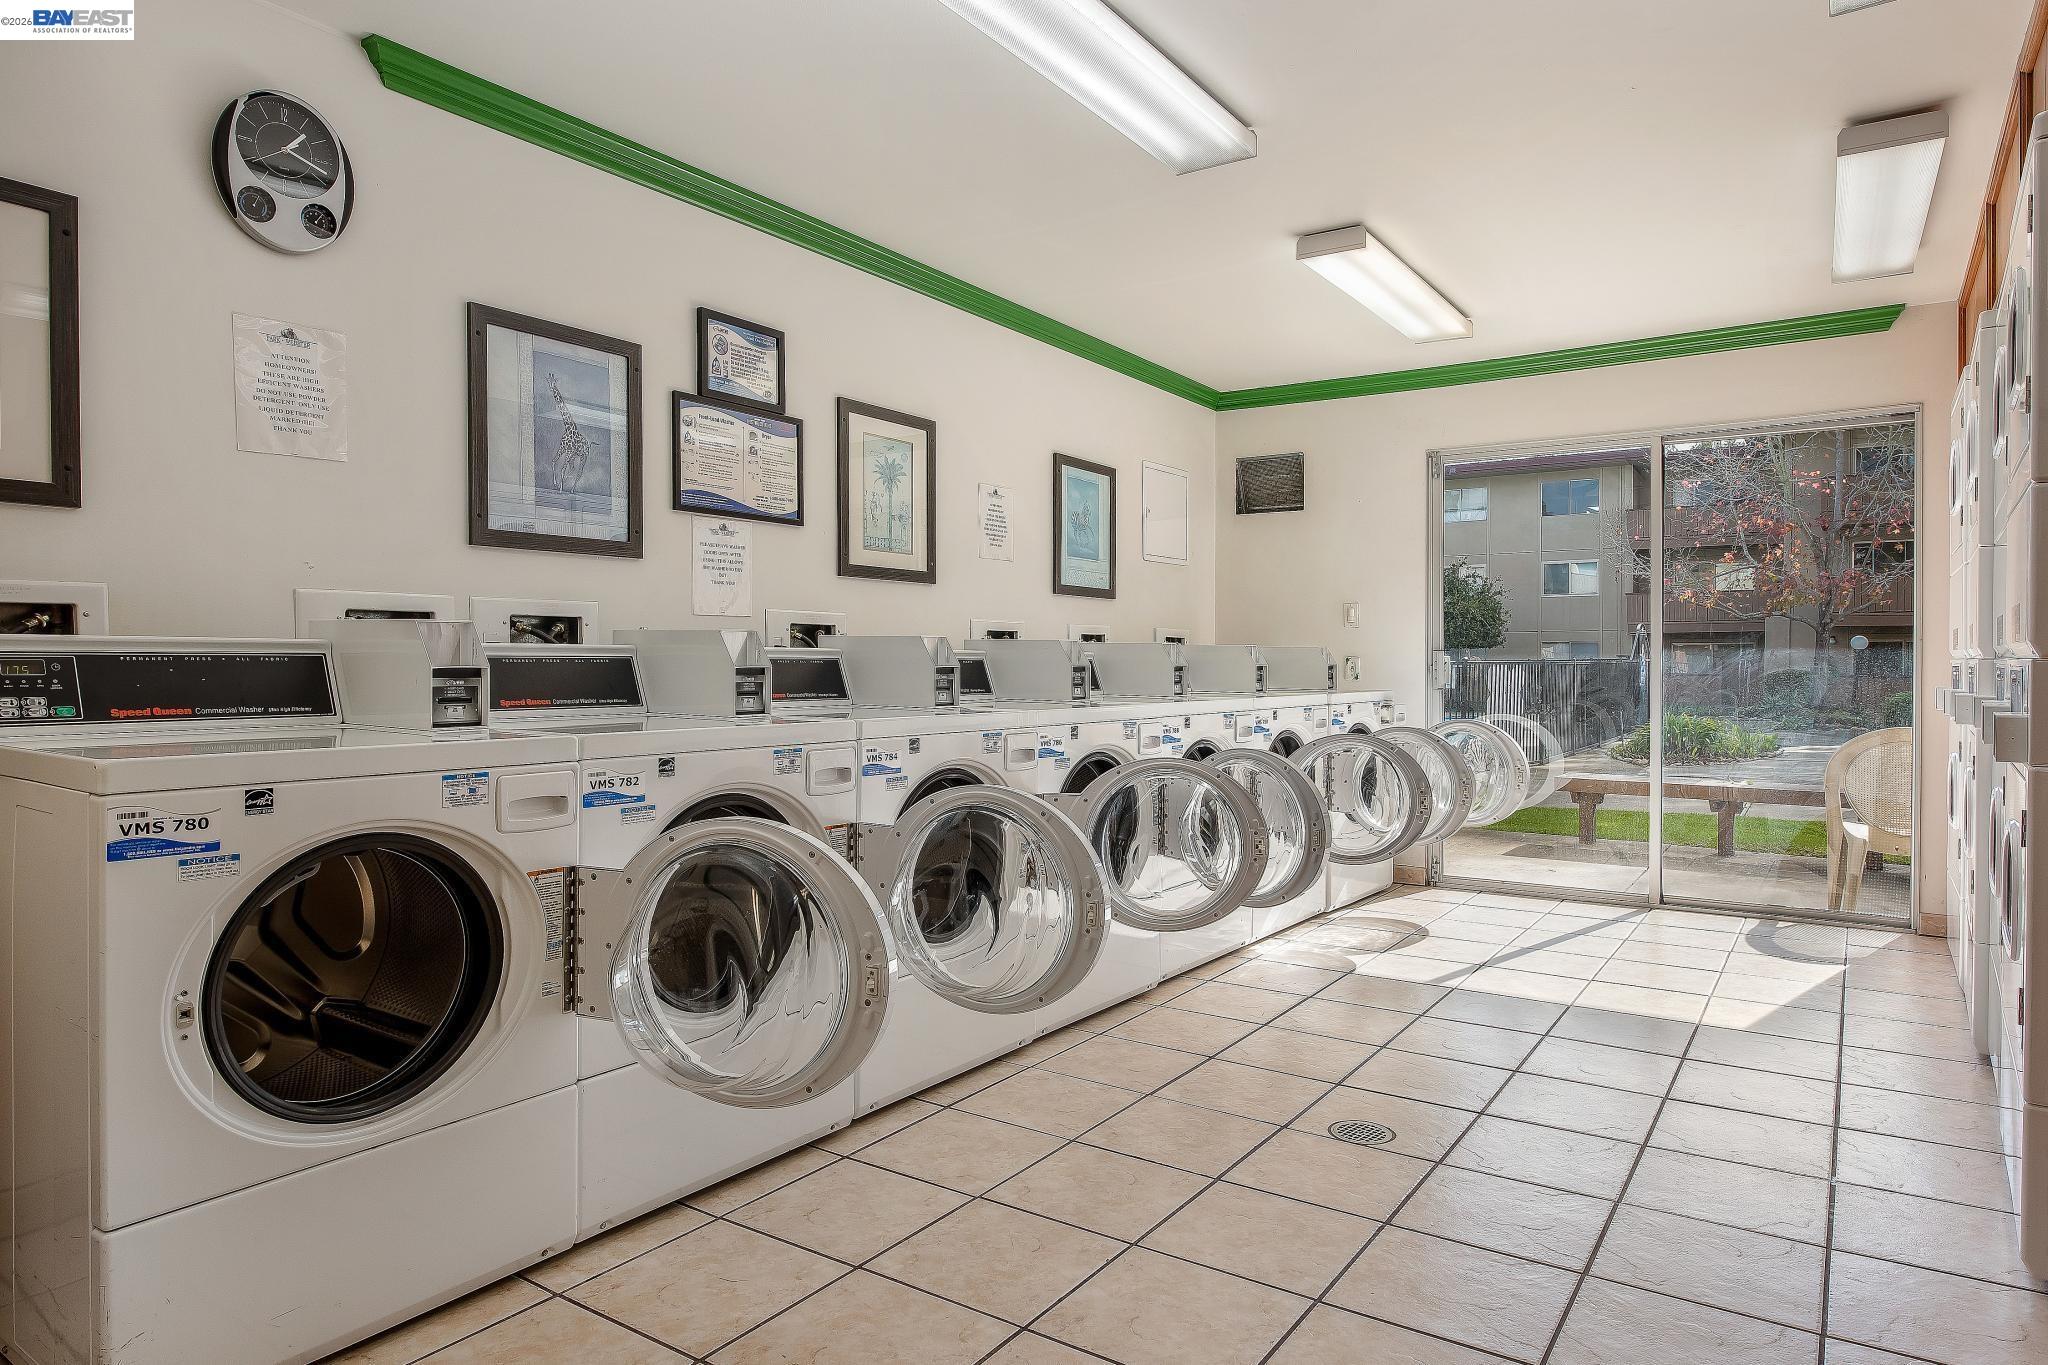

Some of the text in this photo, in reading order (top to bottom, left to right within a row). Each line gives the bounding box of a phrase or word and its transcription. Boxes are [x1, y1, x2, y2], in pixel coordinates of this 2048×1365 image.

[280, 107, 288, 123] 12
[270, 353, 311, 364] ATTENTION
[262, 370, 286, 380] THESE
[293, 383, 325, 394] WASHERS
[253, 395, 330, 412] DETERGENT ONLY USE
[298, 393, 326, 403] POWDER
[259, 405, 325, 420] LIQUID DETERGENT
[269, 415, 301, 425] MARKED
[273, 425, 313, 436] THANK YOU
[500, 698, 526, 707] Speed
[526, 698, 552, 706] Queen
[110, 707, 151, 719] Speed
[153, 707, 193, 716] Queen
[866, 752, 898, 762] VMS 784
[590, 776, 640, 790] VMS 782
[119, 817, 209, 836] VMS 780
[187, 856, 233, 865] NOTICE
